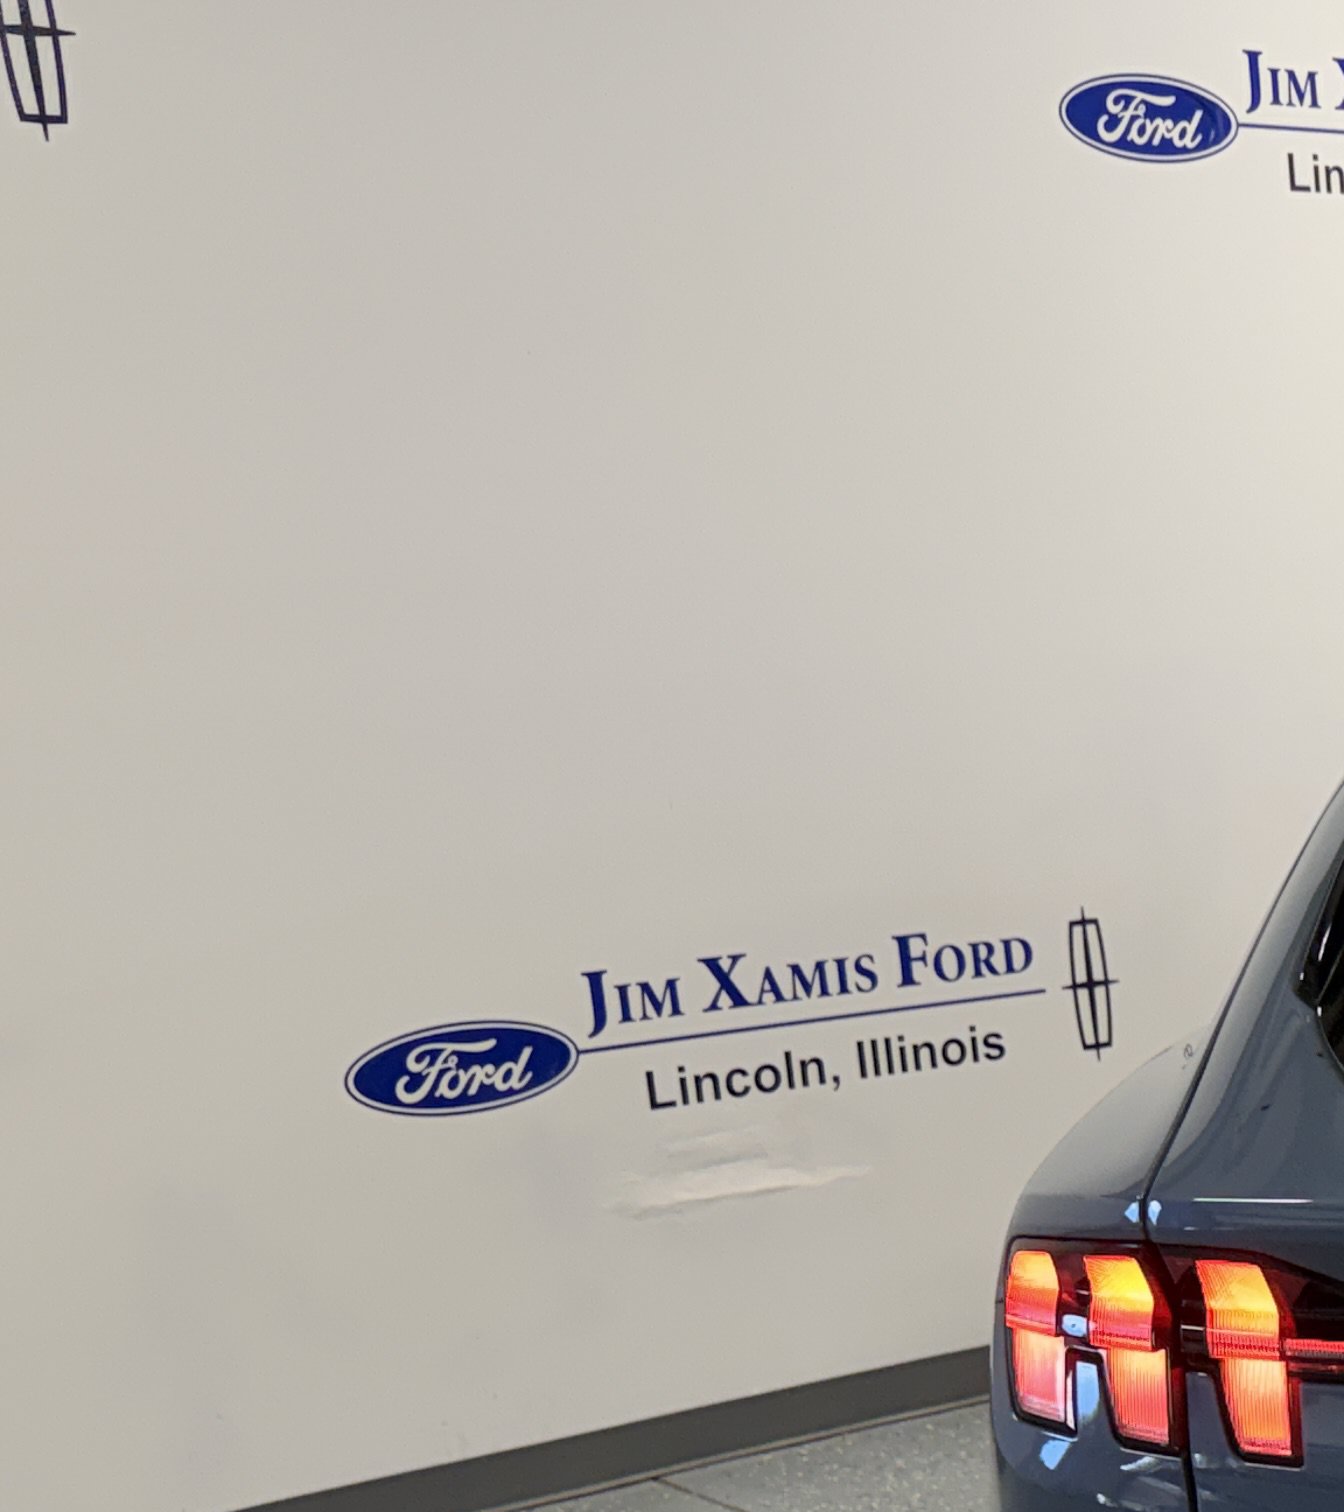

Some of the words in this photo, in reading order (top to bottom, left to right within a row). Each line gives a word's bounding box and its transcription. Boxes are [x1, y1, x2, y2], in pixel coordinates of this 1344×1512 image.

[1242, 49, 1321, 114] JIM
[1097, 87, 1205, 150] Ford
[581, 969, 682, 1039] JIM
[697, 952, 878, 1014] XAMIS
[891, 932, 1034, 989] FORD
[394, 1038, 534, 1105] Ford
[645, 1051, 841, 1111] Lincoln,
[857, 1027, 1007, 1082] Illinois
